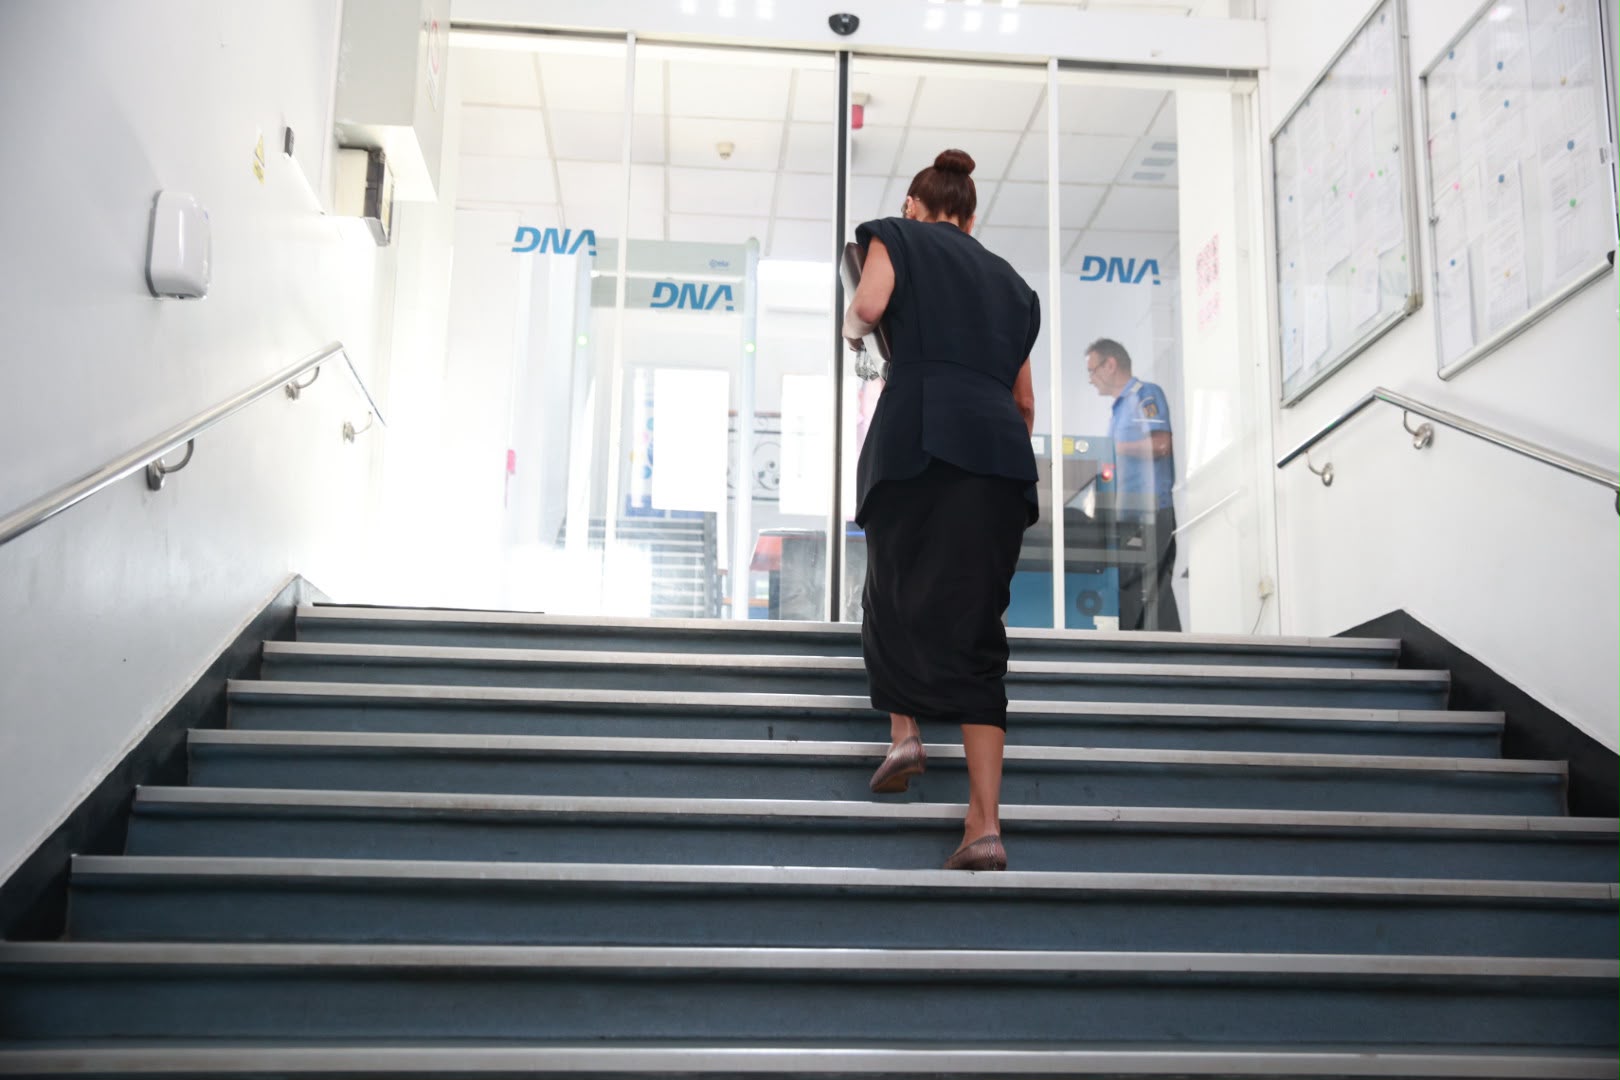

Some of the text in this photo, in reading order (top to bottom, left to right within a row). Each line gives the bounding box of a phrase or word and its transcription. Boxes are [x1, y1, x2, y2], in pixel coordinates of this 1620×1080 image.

[511, 226, 597, 256] DNA
[1080, 255, 1161, 285] DNA
[650, 282, 734, 311] DNA
